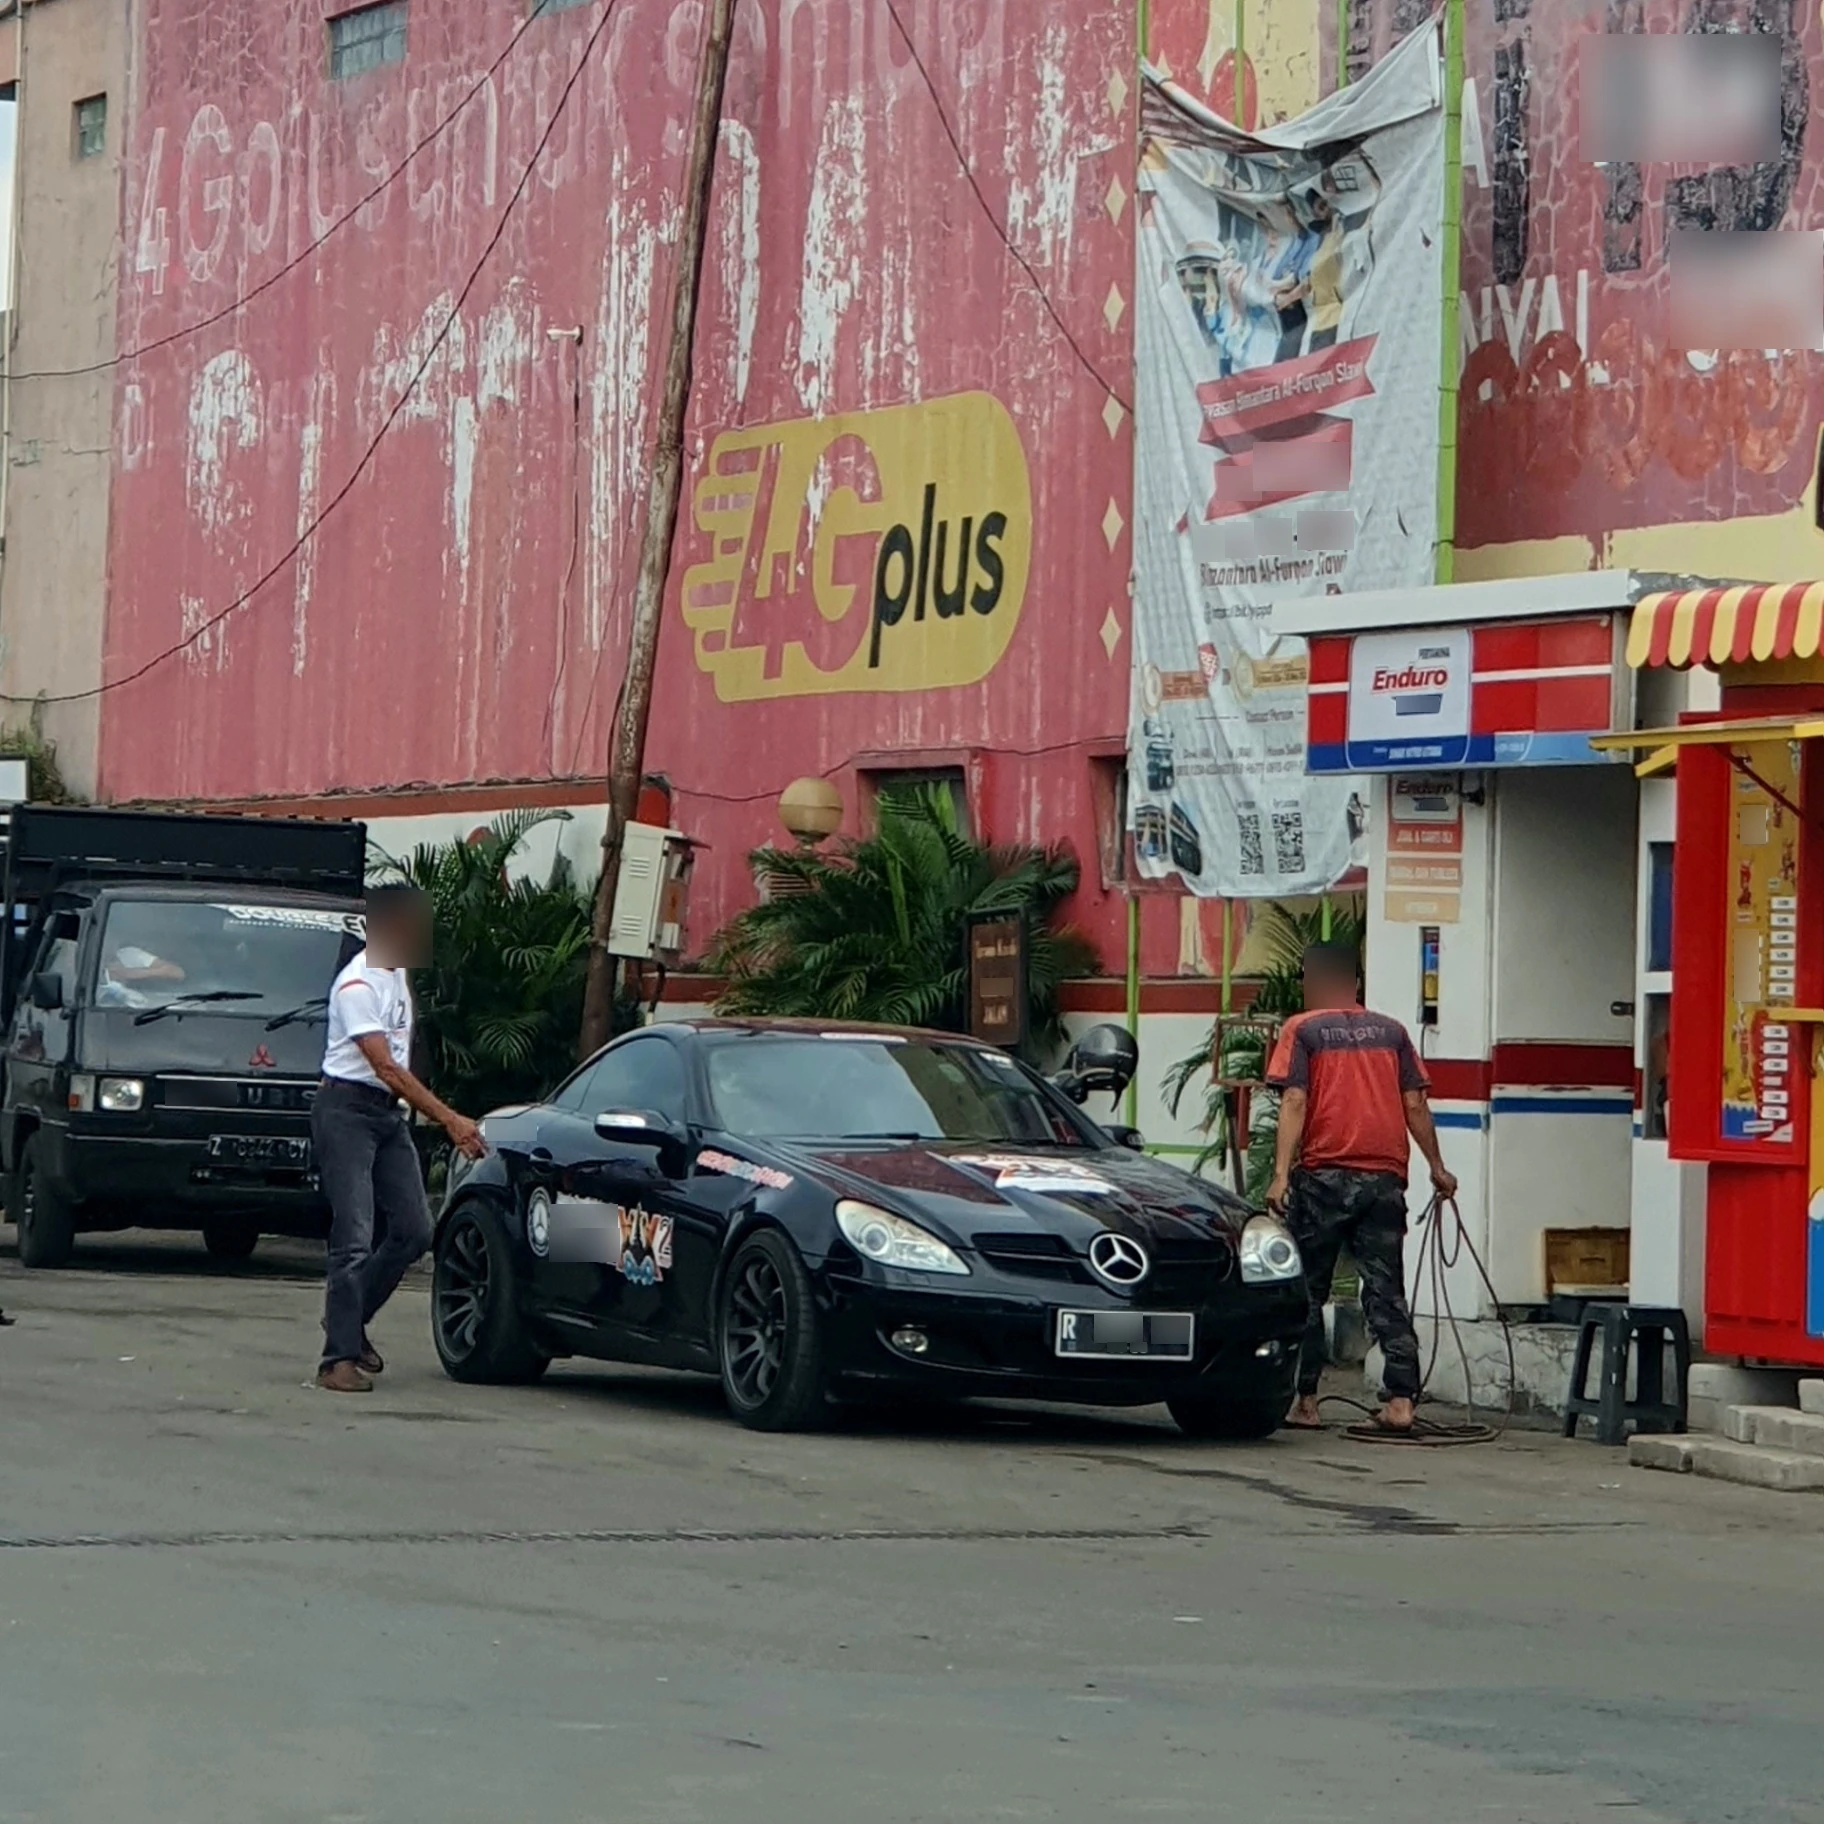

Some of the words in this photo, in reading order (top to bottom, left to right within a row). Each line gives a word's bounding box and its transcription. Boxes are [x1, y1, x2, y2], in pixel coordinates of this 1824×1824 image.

[868, 482, 1008, 669] plus
[1372, 664, 1448, 691] Enduro
[1396, 779, 1453, 795] Enduro
[1062, 1313, 1077, 1340] R
